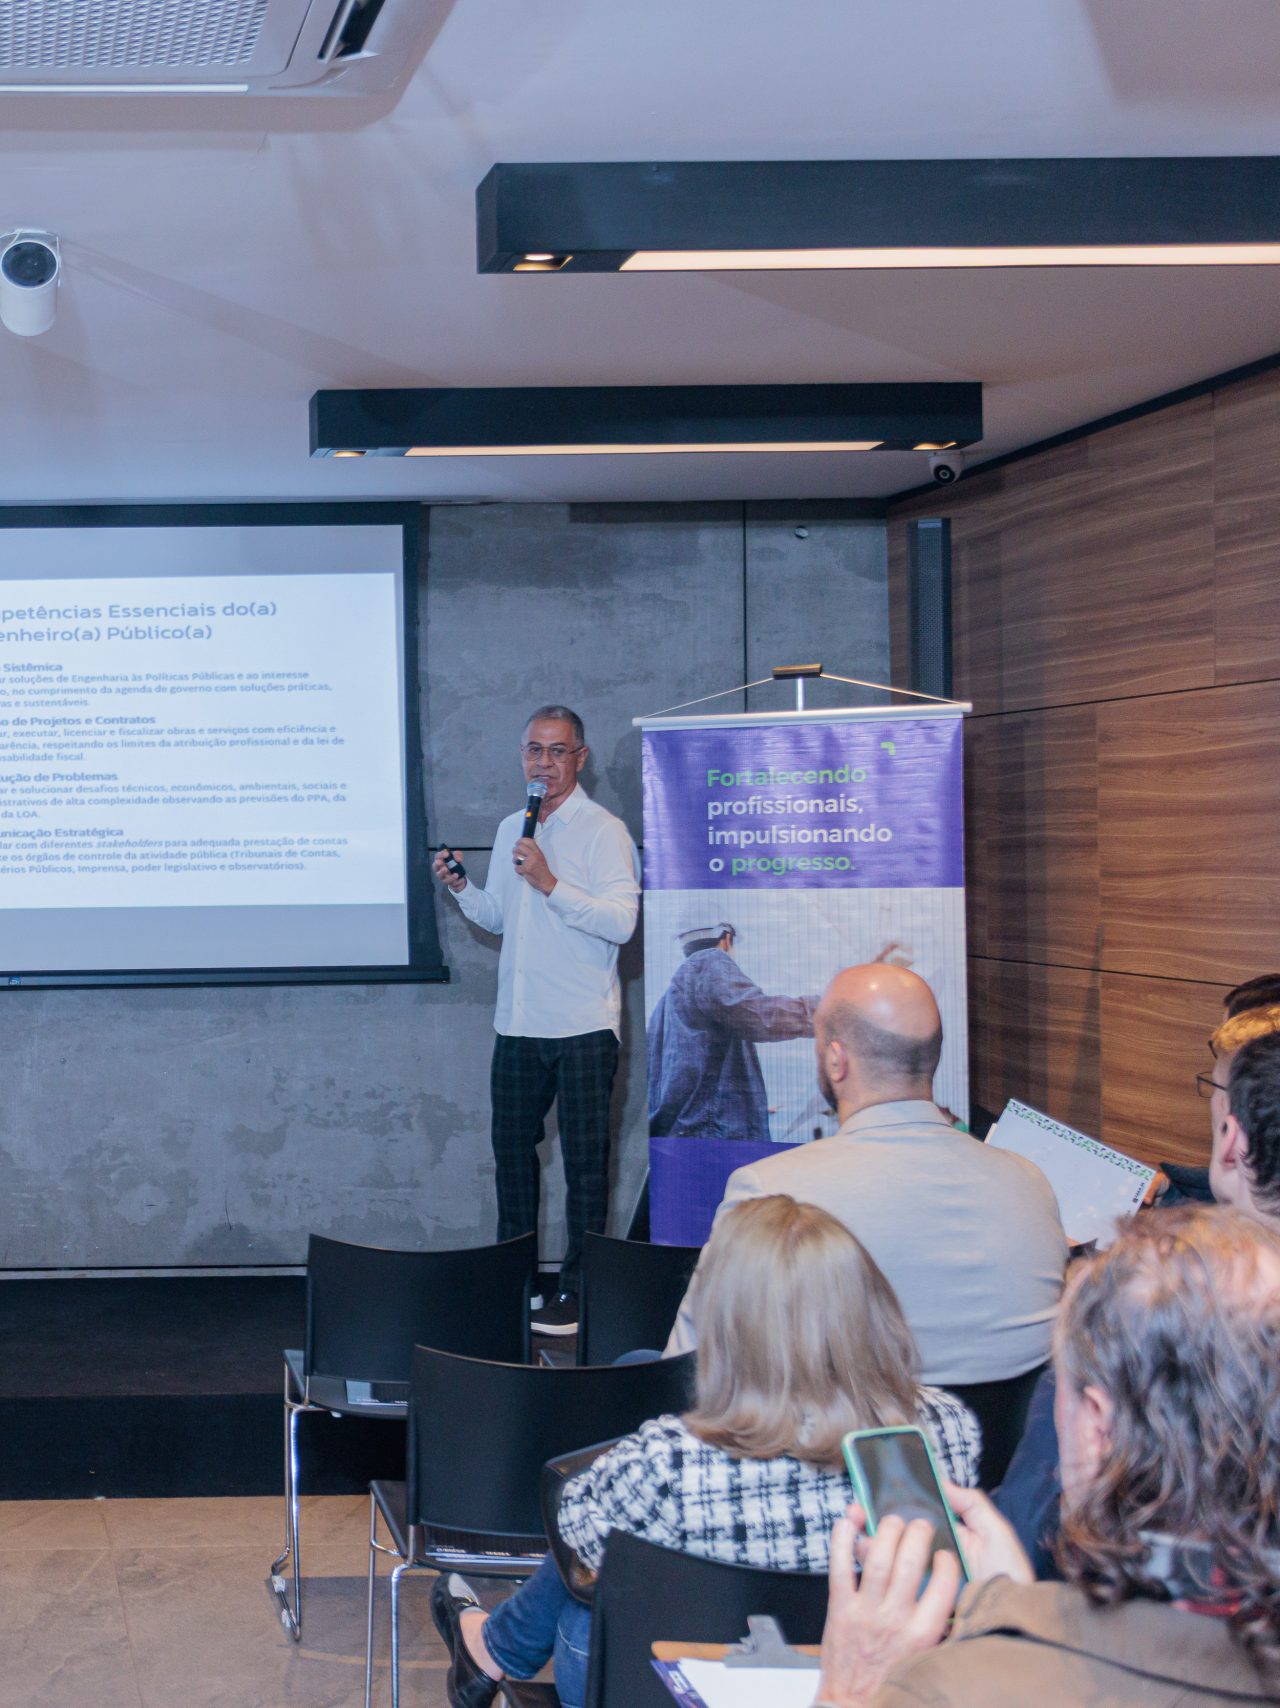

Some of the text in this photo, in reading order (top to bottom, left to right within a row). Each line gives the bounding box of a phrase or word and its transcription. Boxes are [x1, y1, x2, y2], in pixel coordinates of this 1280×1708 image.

[108, 603, 217, 618] Essenciais
[222, 602, 278, 618] do(a)
[107, 626, 212, 640] Público(a)
[3, 662, 63, 672] Sistêmica
[9, 674, 53, 686] soluções
[57, 674, 69, 683] de
[72, 674, 128, 685] Engenharia
[132, 672, 143, 682] às
[146, 672, 189, 682] Políticas
[192, 671, 235, 681] Públicas
[261, 671, 309, 680] interesse
[28, 686, 97, 697] cumprimento
[100, 685, 112, 694] da
[116, 685, 152, 696] agenda
[154, 684, 167, 693] de
[170, 686, 212, 695] governo
[240, 682, 285, 694] soluções
[12, 716, 28, 726] de
[30, 716, 81, 727] Projetos
[95, 714, 156, 724] Contratos
[64, 727, 106, 736] licenciar
[119, 726, 165, 736] fiscalizar
[167, 726, 196, 735] obras
[207, 725, 250, 736] serviços
[277, 724, 327, 733] eficiência
[43, 740, 104, 751] respeitando
[121, 739, 156, 748] limites
[158, 738, 171, 747] da
[174, 737, 227, 749] atribuição
[229, 737, 290, 748] profissional
[302, 736, 314, 745] da
[317, 736, 329, 745] lei
[331, 736, 344, 745] de
[34, 773, 49, 782] de
[52, 772, 118, 782] Problemas
[707, 763, 867, 788] Fortalecendo
[20, 785, 72, 794] solucionar
[76, 784, 119, 793] desafios
[303, 781, 338, 790] sociais
[50, 797, 62, 806] de
[66, 797, 85, 805] alta
[88, 796, 160, 807] complexidade
[162, 795, 223, 804] observando
[239, 793, 288, 805] previsões
[291, 794, 304, 802] do
[333, 793, 346, 802] da
[707, 793, 864, 820] profissionais,
[1, 810, 13, 818] da
[55, 826, 124, 839] Estratégica
[708, 823, 892, 849] impulsionando
[40, 840, 92, 849] diferentes
[98, 839, 163, 848] stakeholders
[165, 840, 188, 849] para
[190, 838, 240, 849] adequada
[243, 836, 294, 848] prestação
[297, 837, 309, 846] de
[313, 836, 348, 845] contas
[26, 852, 60, 863] órgãos
[63, 852, 75, 861] de
[78, 852, 121, 860] controle
[124, 851, 136, 860] da
[140, 851, 187, 860] atividade
[190, 850, 227, 861] pública
[230, 850, 282, 860] (Tribunais
[285, 849, 298, 858] de
[132, 863, 161, 874] poder
[165, 862, 217, 873] legislativo
[709, 855, 856, 876] o progresso.
